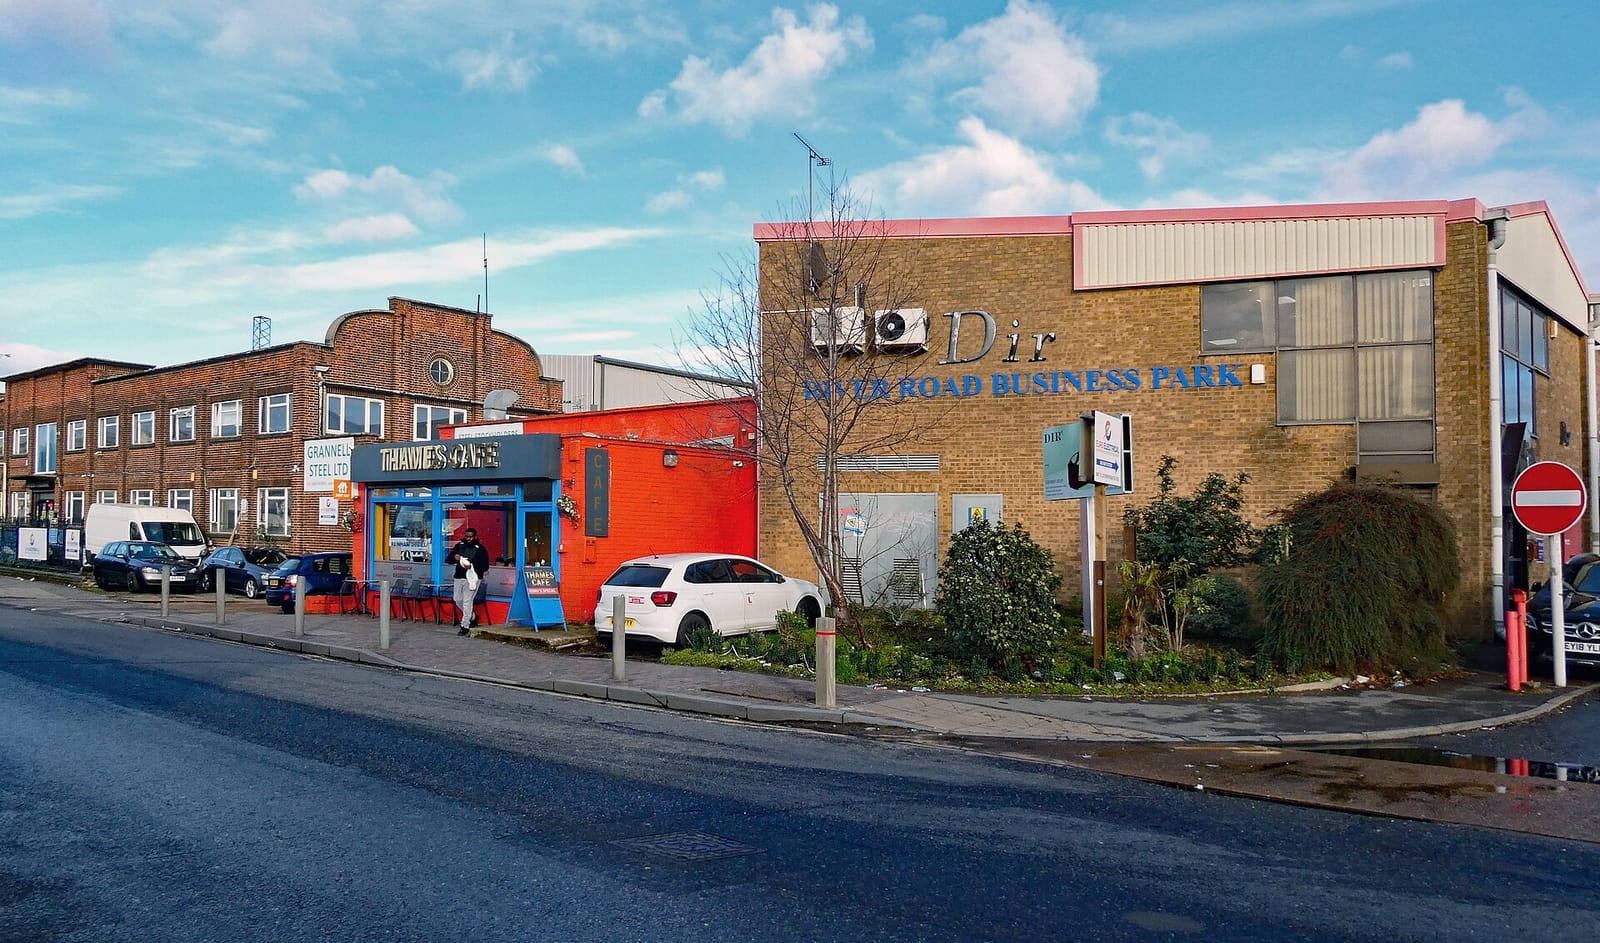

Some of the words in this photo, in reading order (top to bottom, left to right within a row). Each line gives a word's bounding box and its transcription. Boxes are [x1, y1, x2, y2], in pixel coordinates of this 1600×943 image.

[938, 309, 1056, 366] Dir
[803, 378, 891, 402] RIVER
[898, 374, 983, 399] ROAD
[991, 367, 1142, 397] BUSINESS
[1150, 363, 1244, 390] PARK
[307, 443, 351, 459] GRANNELL
[380, 444, 447, 471] THAMES
[449, 441, 500, 469] CAFE
[309, 463, 332, 477] STEEL
[334, 462, 349, 476] LTD
[593, 454, 603, 533] CAFE
[525, 571, 554, 579] THAMES
